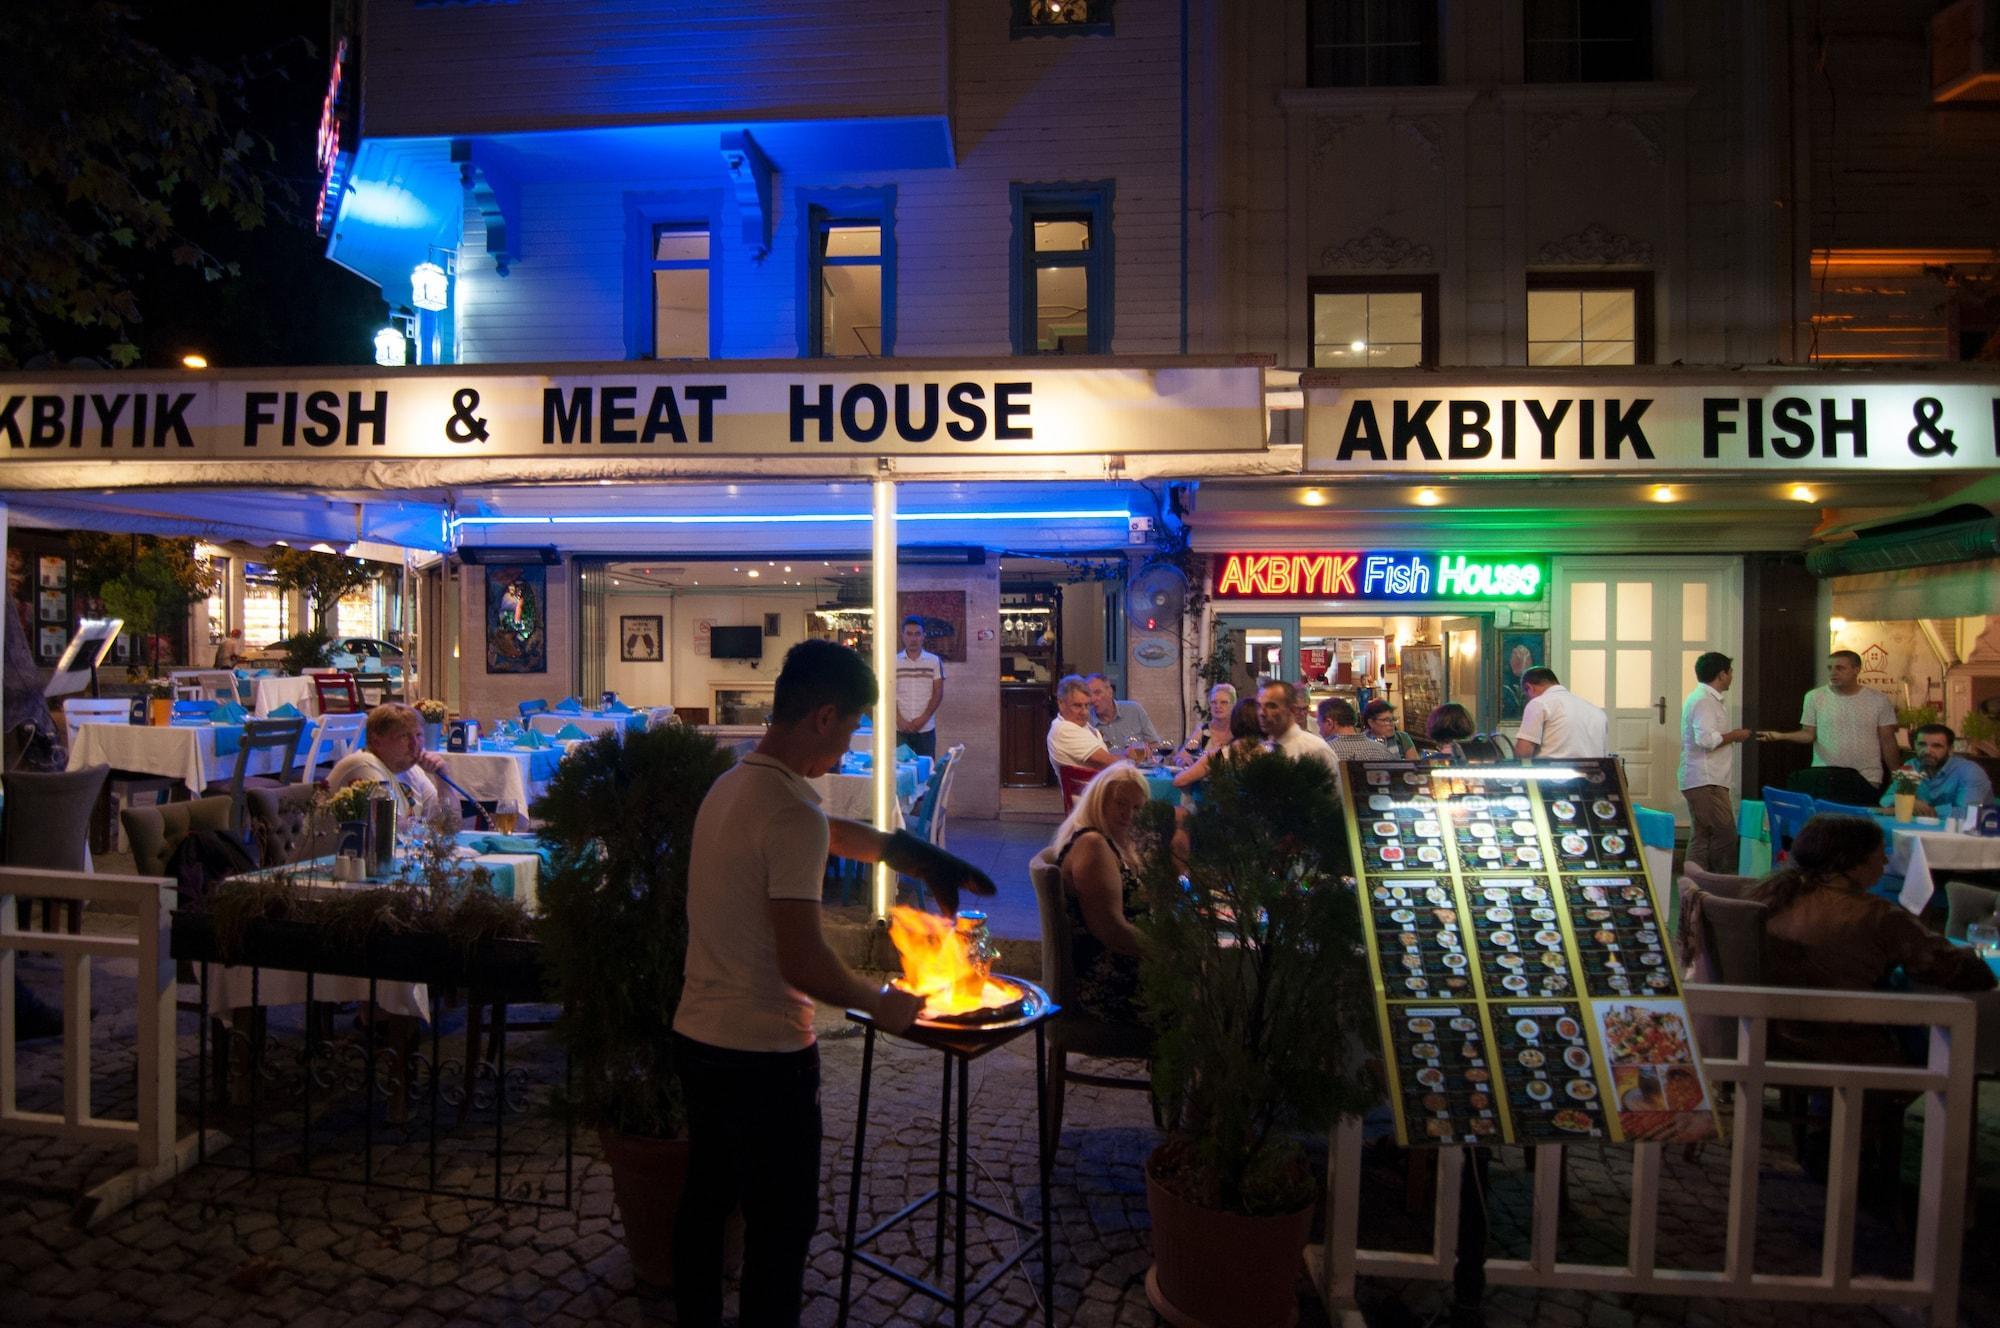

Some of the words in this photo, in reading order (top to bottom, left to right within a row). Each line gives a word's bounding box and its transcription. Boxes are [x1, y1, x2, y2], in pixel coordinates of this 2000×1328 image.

[244, 390, 388, 448] FISH
[446, 388, 489, 443] &
[543, 385, 727, 444] MEAT
[789, 384, 1032, 443] HOUSE
[1336, 398, 1655, 461] AKBIYIK
[1703, 397, 1868, 459] FISH
[1908, 397, 1958, 456] &
[1219, 555, 1358, 595] AKBIYIK
[1364, 556, 1429, 595] Fish
[1438, 555, 1541, 596] House
